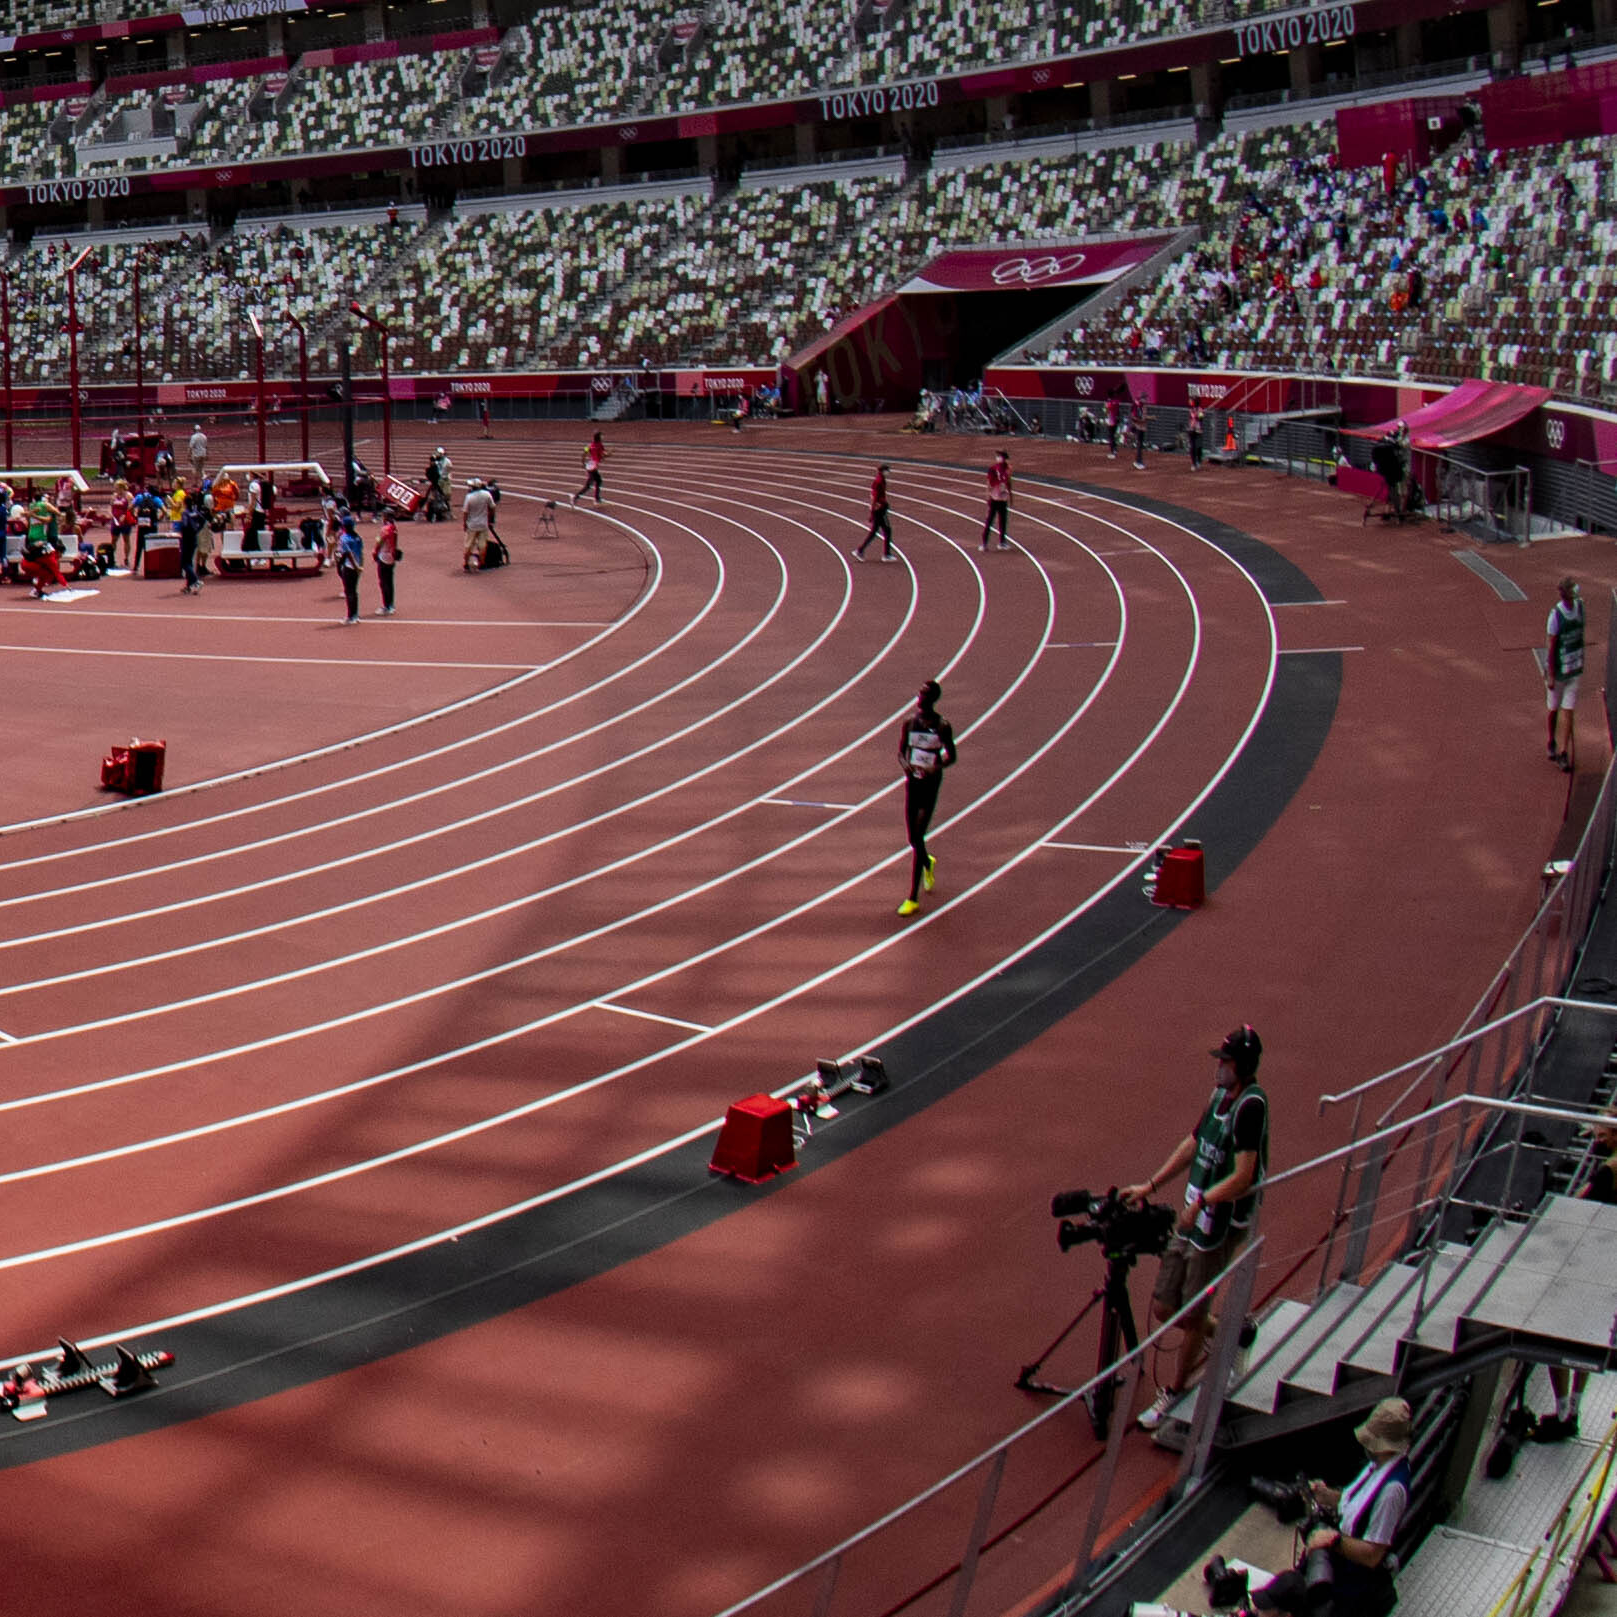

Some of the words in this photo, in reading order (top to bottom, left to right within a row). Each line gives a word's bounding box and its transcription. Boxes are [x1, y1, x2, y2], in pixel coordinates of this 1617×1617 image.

[203, 2, 248, 23] TOKYO
[1234, 17, 1301, 57] TOKYO
[1305, 5, 1355, 44] 2020
[820, 89, 885, 120] TOKYO
[890, 82, 939, 112] 2020
[408, 142, 474, 168] TOKYO
[478, 136, 526, 162] 2020
[26, 182, 83, 204] TOKYO
[88, 178, 130, 197] 2020
[187, 390, 208, 399] TOKYO
[209, 389, 226, 398] 2020
[451, 383, 473, 392] TOKYO
[474, 383, 490, 392] 2020
[704, 378, 726, 388] TOKYO
[727, 378, 744, 388] 2020
